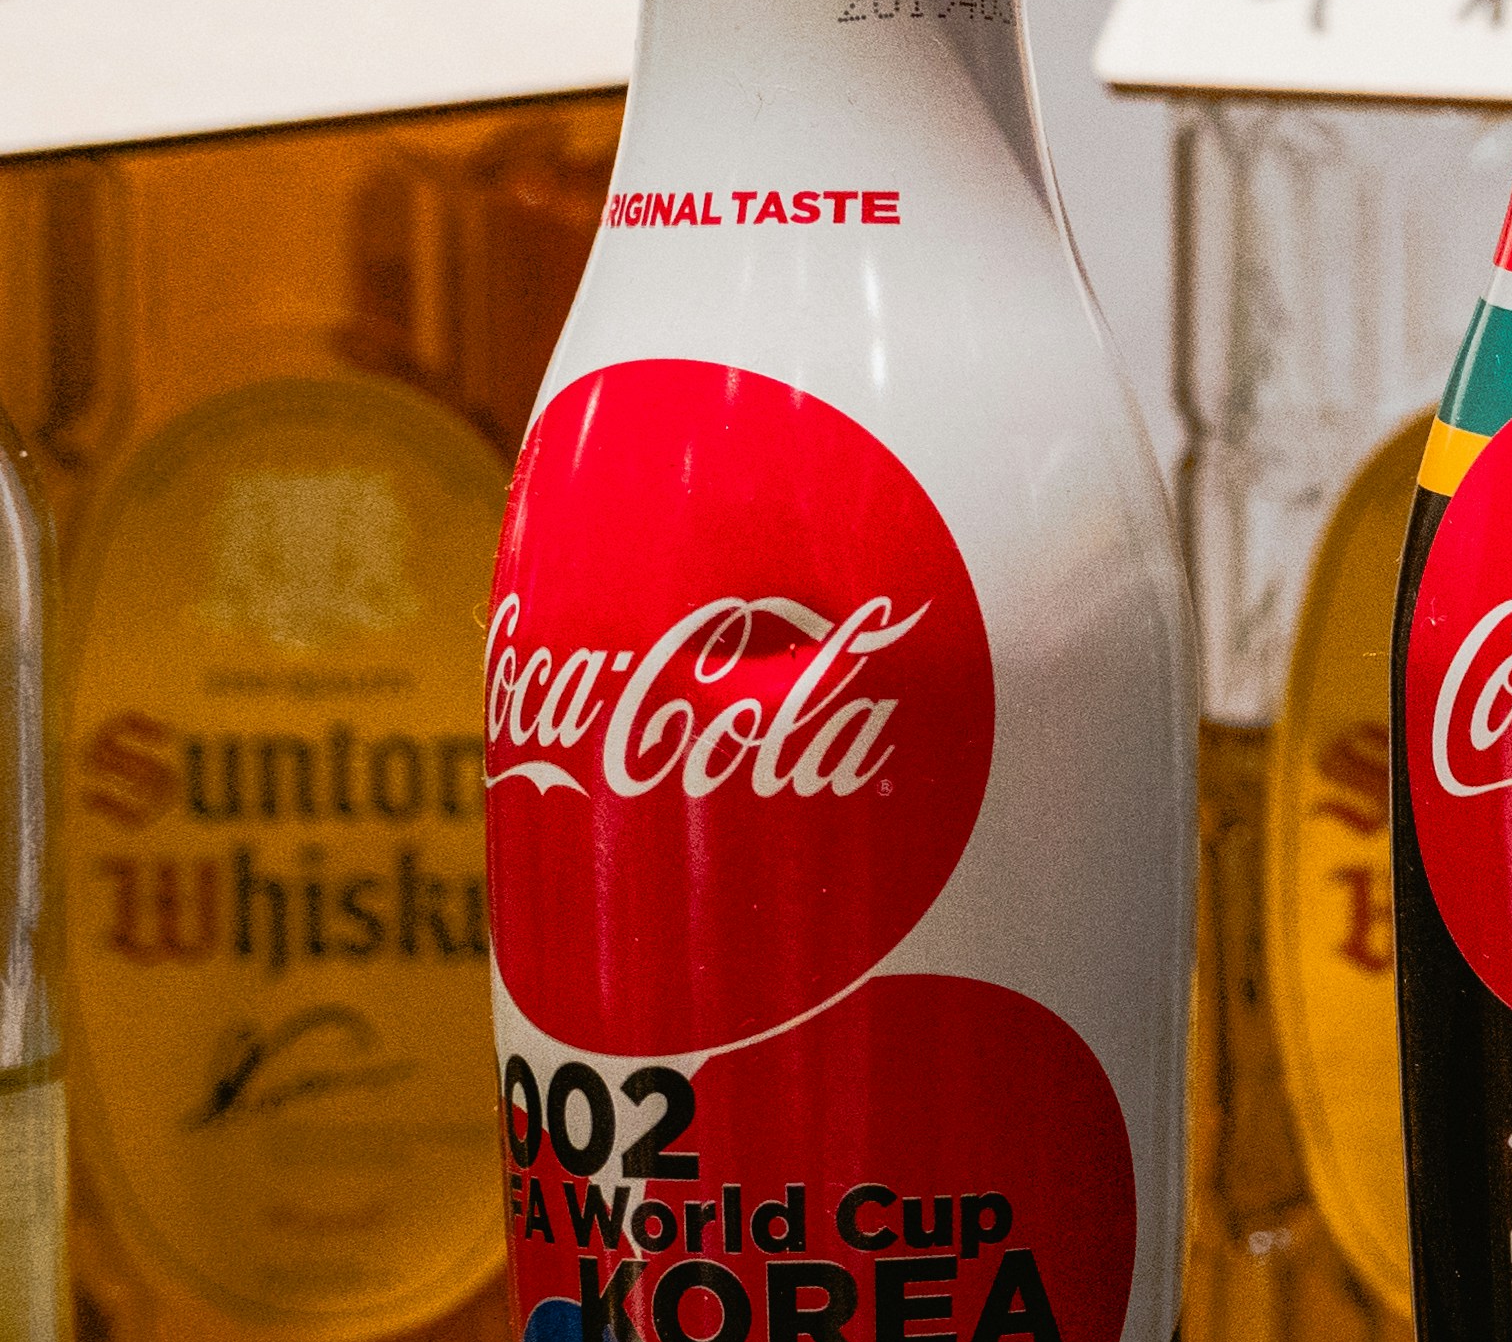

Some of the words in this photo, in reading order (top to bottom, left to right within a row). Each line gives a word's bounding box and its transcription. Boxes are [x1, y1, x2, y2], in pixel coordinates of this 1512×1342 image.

[731, 190, 901, 226] TASTE
[565, 1183, 807, 1256] World
[835, 1182, 1013, 1260] Cup
